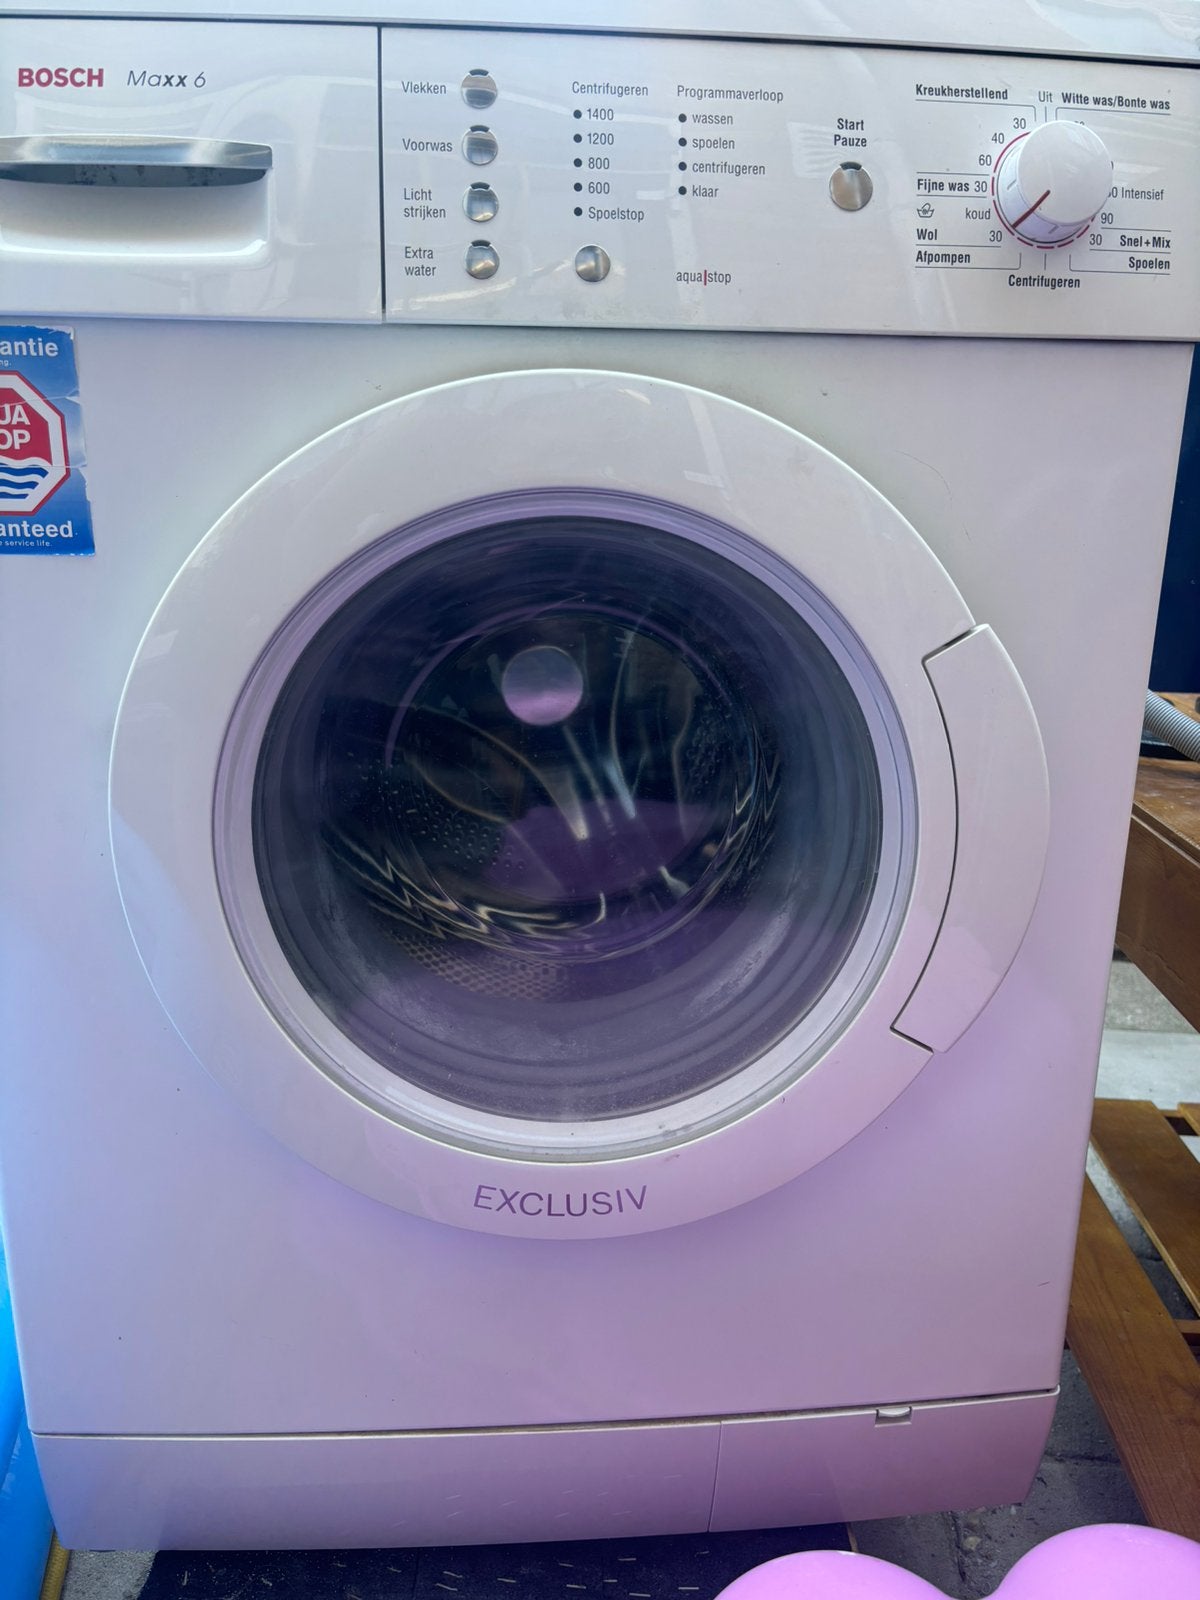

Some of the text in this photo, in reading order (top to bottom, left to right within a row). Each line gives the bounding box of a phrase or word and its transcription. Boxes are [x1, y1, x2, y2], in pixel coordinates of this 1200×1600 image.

[18, 68, 206, 88] BOSCH Maxx 6
[401, 81, 447, 94] Vlekken
[572, 81, 648, 97] Centrifugeren
[915, 84, 1008, 100] Kreukherstellend
[677, 85, 784, 104] Programmaverloop
[1038, 90, 1053, 103] Uit
[1061, 92, 1170, 110] Witte was/Bonte was
[586, 108, 614, 121] 1400
[692, 114, 733, 126] wassen
[836, 118, 865, 131] Start
[1013, 117, 1026, 130] 30
[587, 133, 614, 146] 1200
[692, 136, 735, 150] spoelen
[834, 134, 867, 148] Pauze
[991, 132, 1004, 144] 40
[402, 138, 453, 152] Voorwas
[588, 157, 610, 170] 800
[978, 154, 992, 166] 60
[692, 161, 766, 177] centrifugeren
[588, 182, 610, 195] 600
[692, 185, 719, 198] klaar
[917, 178, 969, 193] Fijne was
[974, 181, 987, 193] 30
[403, 188, 432, 201] Licht
[1108, 187, 1164, 200] 0 Intensief
[403, 205, 446, 219] strijken
[588, 207, 644, 223] Spoelstop
[965, 207, 991, 220] koud
[1100, 213, 1114, 225] 90
[916, 228, 938, 241] Wol
[989, 230, 1002, 243] 30
[1089, 233, 1102, 246] 30
[404, 246, 434, 260] Extra
[916, 250, 971, 266] Afpompen
[404, 263, 436, 277] water
[1128, 256, 1170, 271] Spoelen
[1008, 274, 1081, 290] Centrifugeren
[473, 1184, 648, 1217] EXCLUSIV
